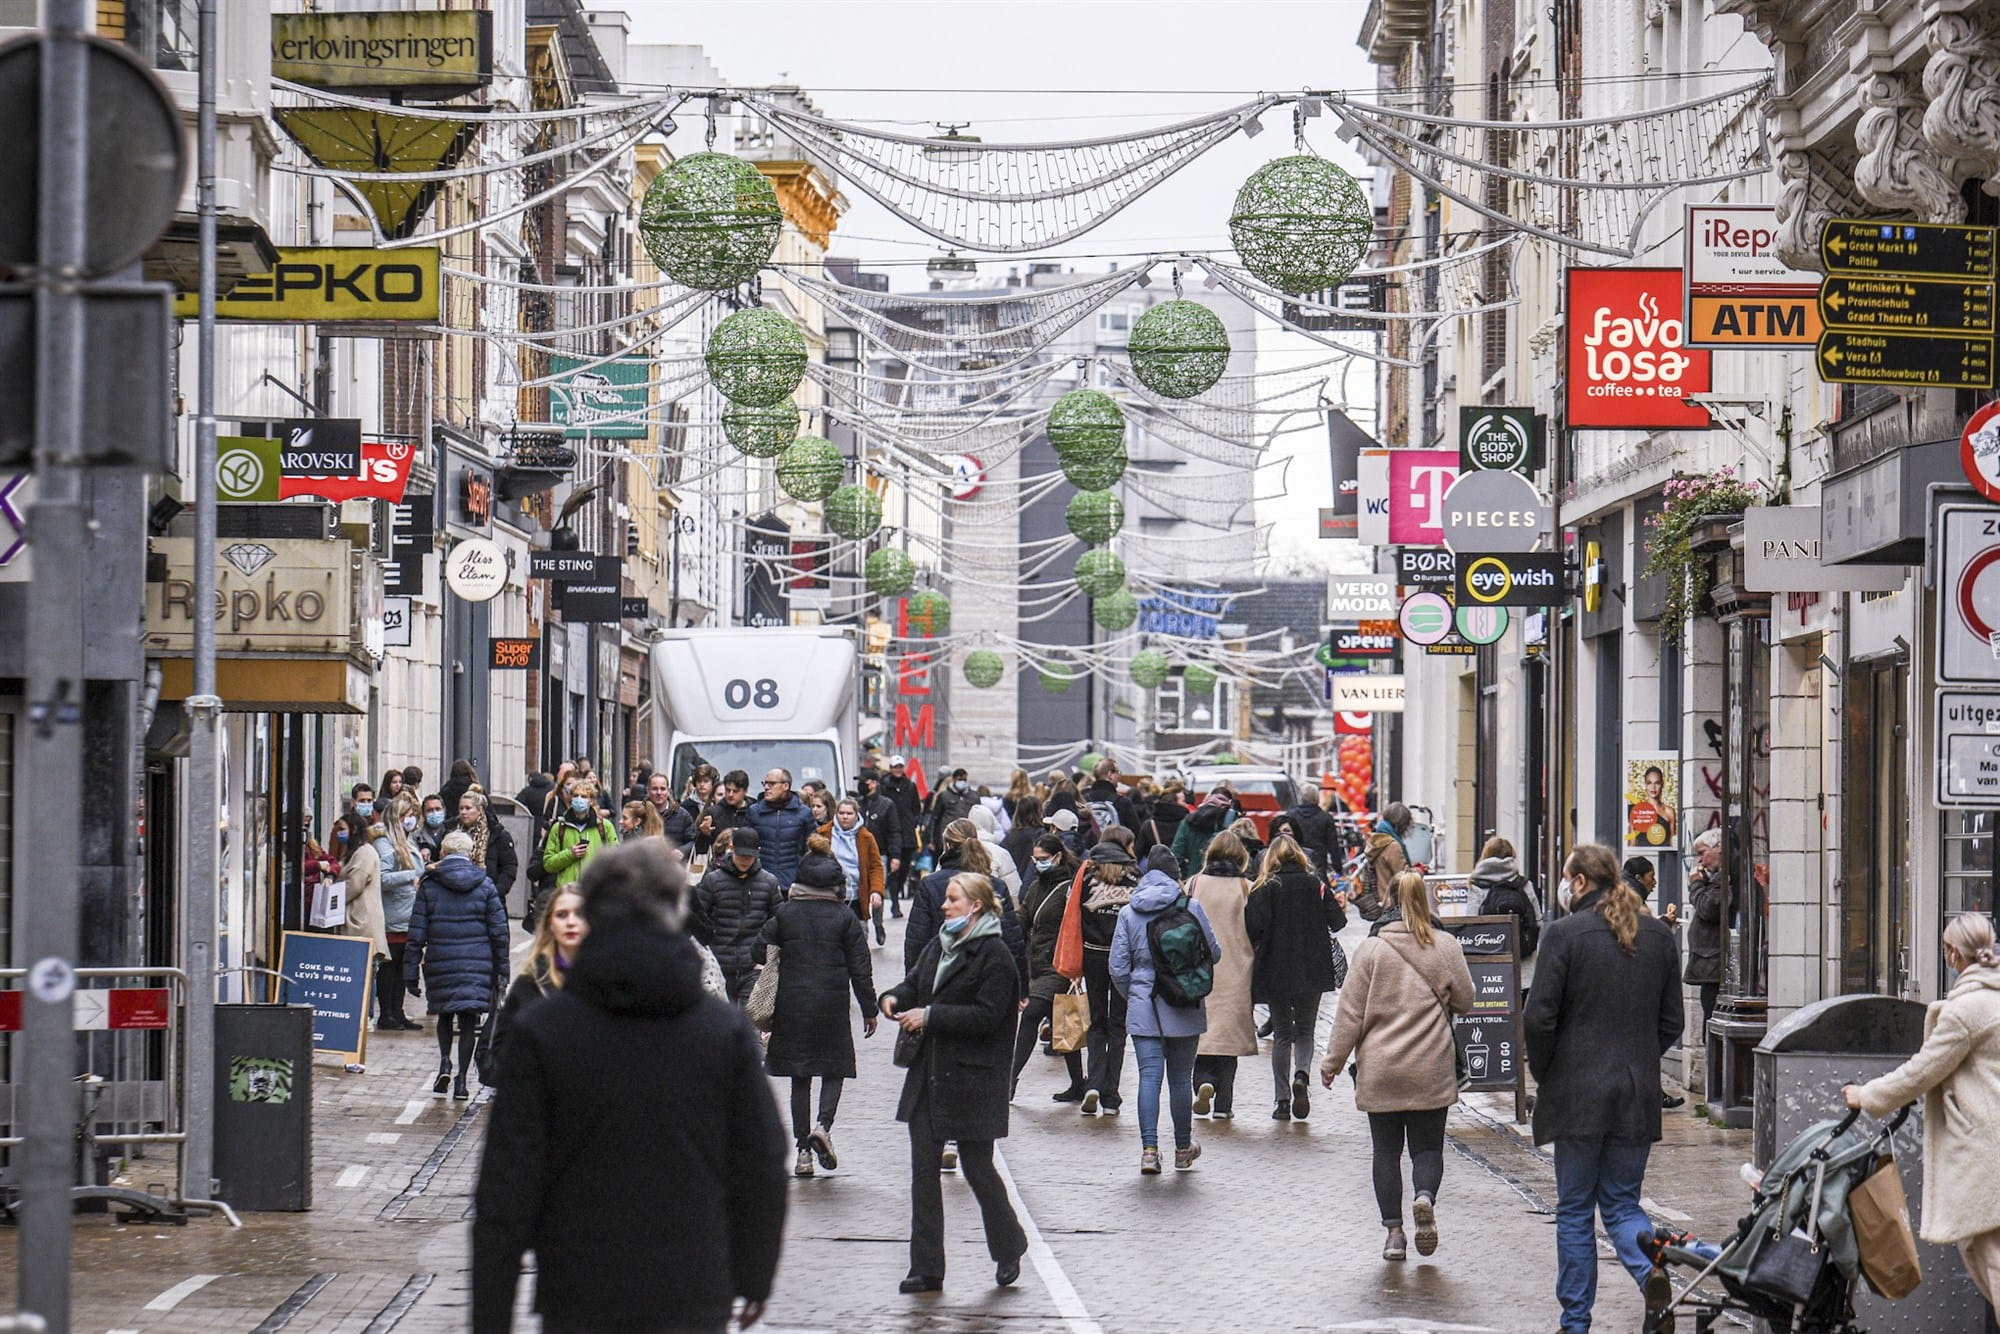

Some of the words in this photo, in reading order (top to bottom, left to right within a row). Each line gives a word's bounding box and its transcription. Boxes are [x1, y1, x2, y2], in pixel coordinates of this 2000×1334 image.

[1849, 226, 1878, 236] Forum
[1965, 232, 1972, 241] 4
[1704, 219, 1780, 257] iRep
[1849, 242, 1873, 252] Grote
[1877, 243, 1904, 253] Markt
[1968, 247, 1973, 256] 1
[1974, 249, 1989, 257] min
[1848, 256, 1879, 267] Politie
[1966, 262, 1972, 271] 7
[1974, 264, 1988, 272] min
[176, 264, 423, 302] EPKO
[1848, 282, 1901, 293] Martinikerk
[1963, 287, 1971, 297] 4
[1847, 297, 1910, 309] Provinciehuis
[1963, 302, 1970, 312] 5
[1972, 304, 1988, 312] min
[1711, 305, 1806, 336] ATM
[1847, 312, 1875, 322] Grand
[1878, 313, 1913, 324] Theatre
[1963, 317, 1970, 326] 2
[1972, 319, 1988, 327] min
[1584, 307, 1683, 348] favo
[1846, 337, 1887, 348] Stadhuis
[1965, 342, 1969, 352] 1
[1971, 344, 1987, 352] min
[1846, 353, 1867, 363] Vera
[1961, 357, 1968, 366] 4
[1971, 359, 1986, 367] min
[1584, 346, 1690, 382] losa
[1845, 367, 1925, 381] Stadsschouwburg
[1961, 372, 1968, 381] 8
[1970, 374, 1986, 382] min
[1587, 382, 1633, 397] coffee
[1658, 384, 1682, 397] tea
[1487, 433, 1508, 442] THE
[1480, 443, 1517, 453] BODY
[1481, 453, 1515, 463] SHOP
[1451, 511, 1536, 527] PIECES
[459, 549, 493, 565] Miss
[533, 559, 555, 570] THE
[558, 559, 594, 571] STING
[458, 564, 496, 580] Etam
[1471, 568, 1554, 590] eyewish
[1335, 583, 1389, 596] VERO
[1331, 598, 1392, 612] MODA
[496, 641, 533, 656] Super
[724, 678, 780, 710] 08
[1341, 688, 1369, 699] VAN
[1374, 688, 1405, 699] LIER
[1980, 761, 1998, 772] Ma
[1977, 776, 1998, 786] van
[299, 962, 321, 970] COME
[295, 971, 319, 979] LEVI'S
[323, 974, 351, 982] PROMO
[1481, 975, 1503, 983] TAKE
[1481, 986, 1505, 994] AWAY
[1464, 1016, 1481, 1024] ANTI
[1500, 1041, 1511, 1057] GO
[1500, 1059, 1511, 1073] TO
